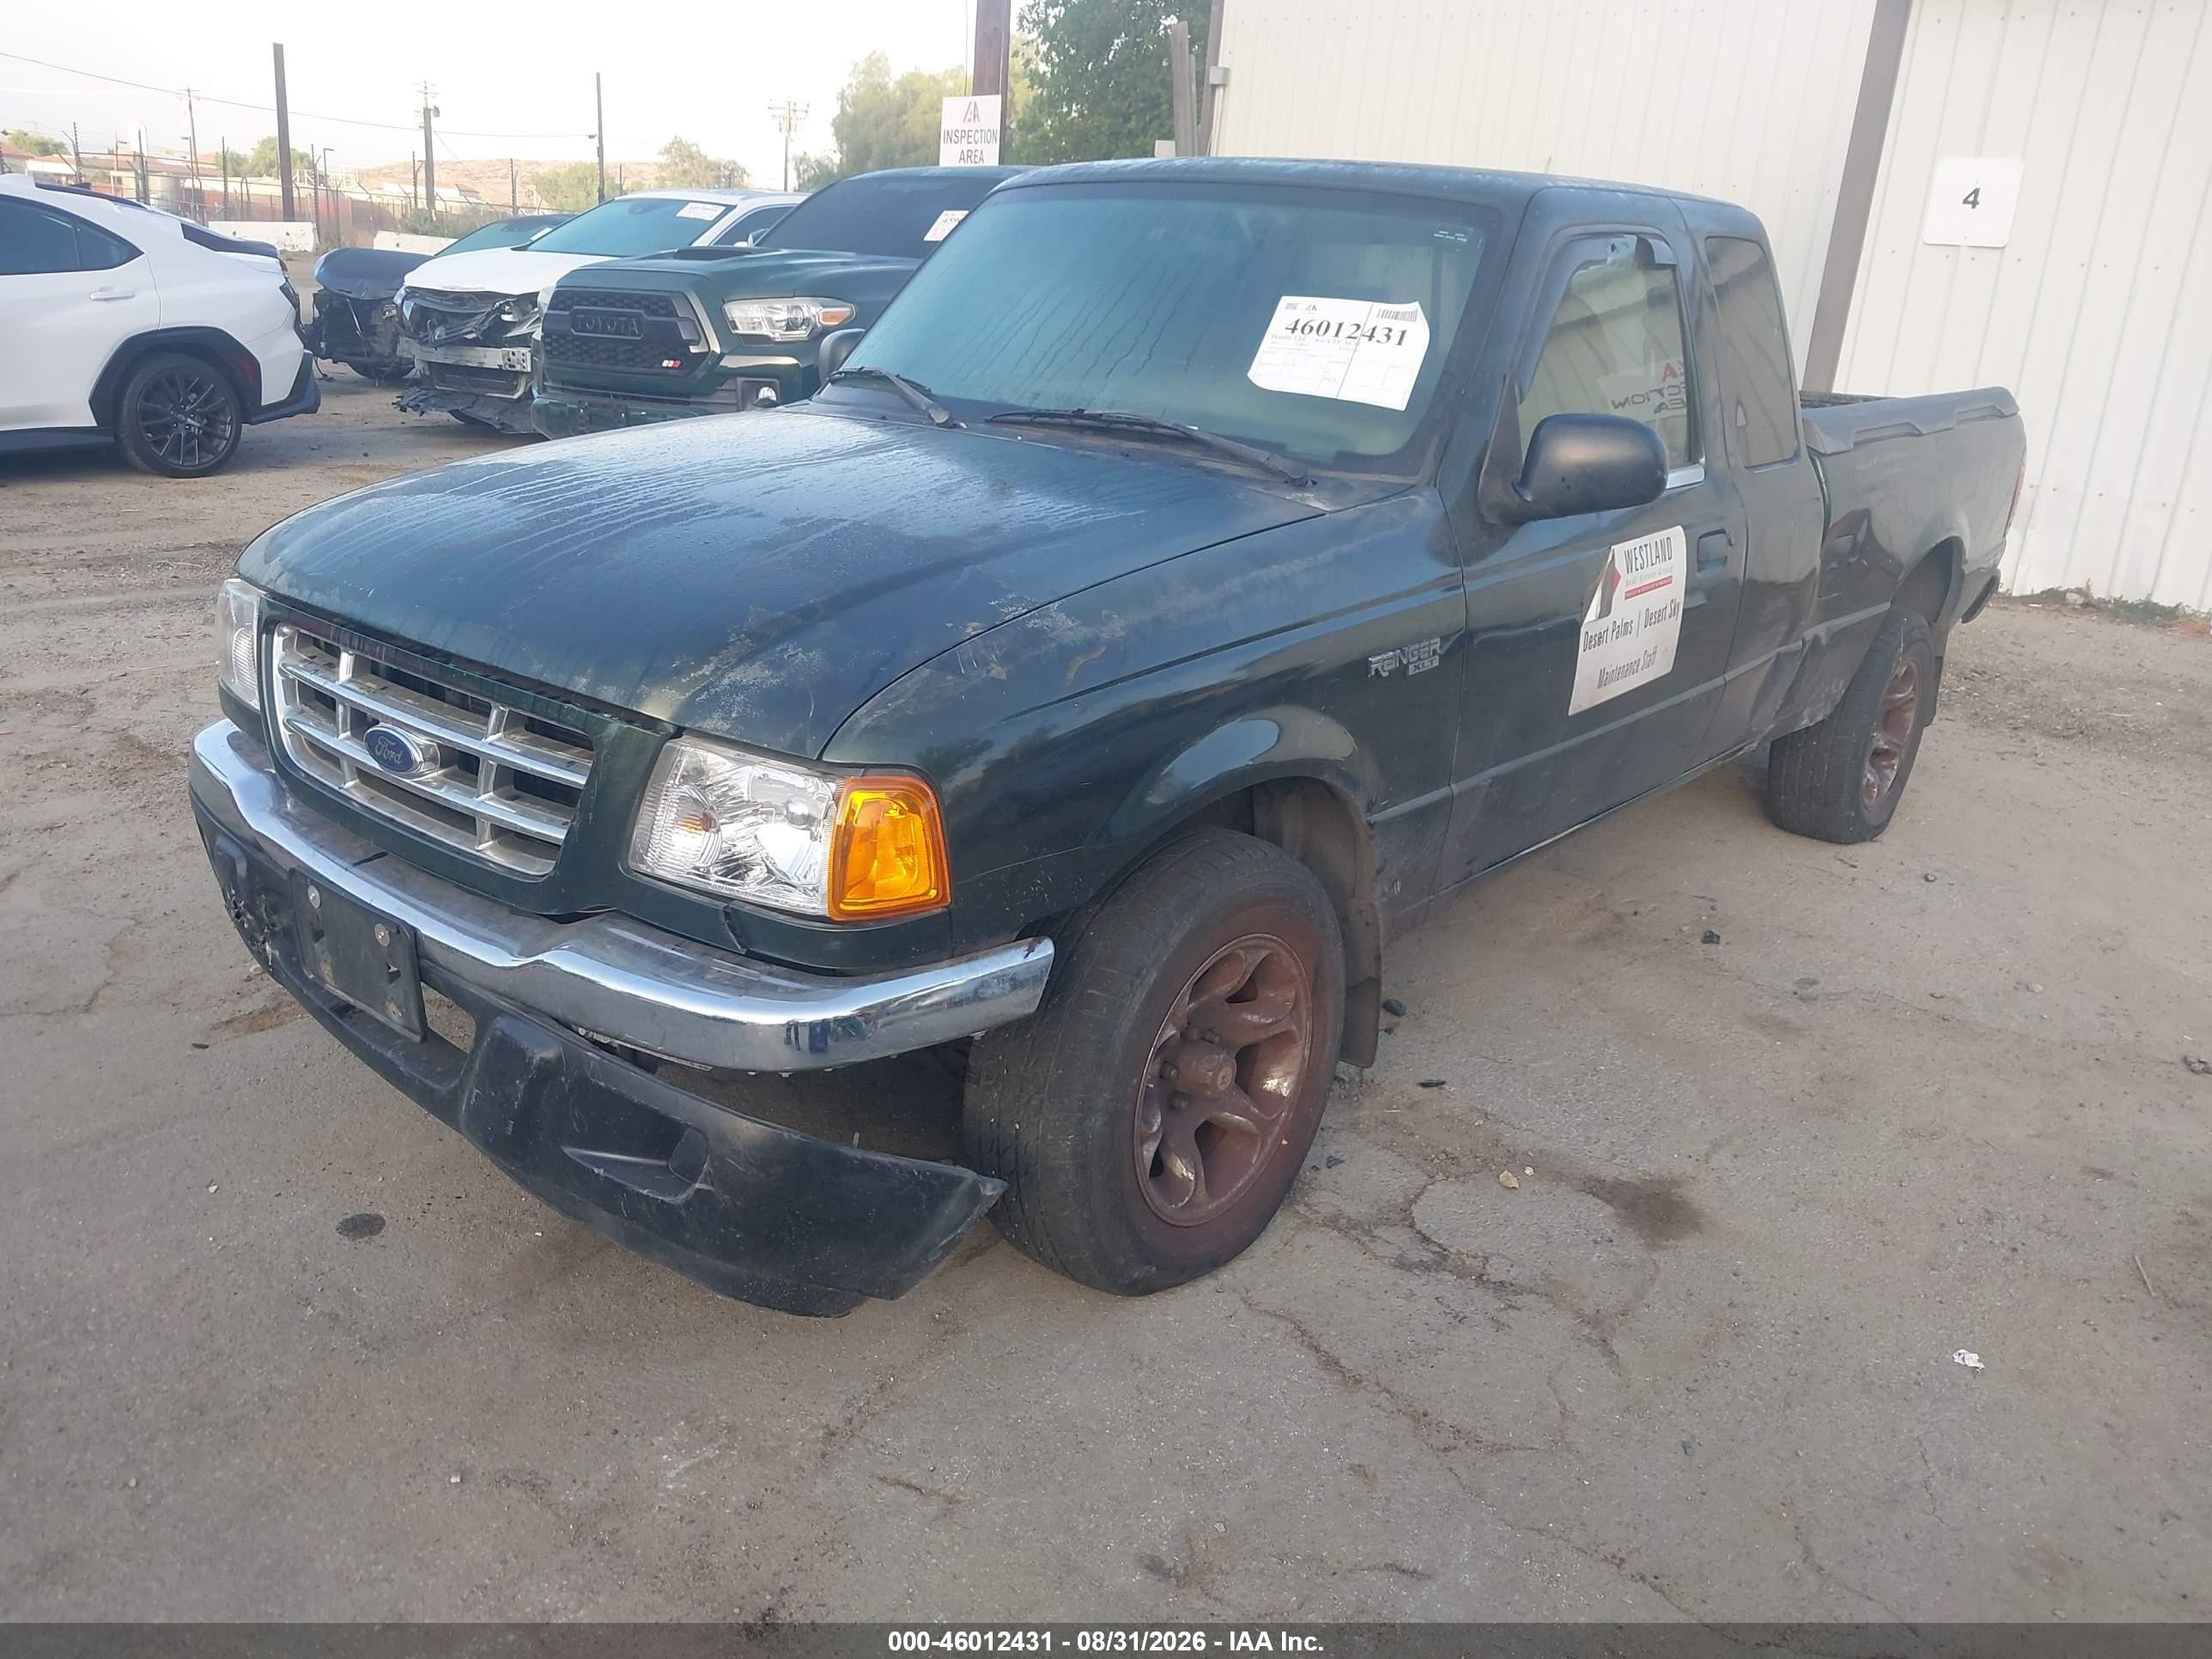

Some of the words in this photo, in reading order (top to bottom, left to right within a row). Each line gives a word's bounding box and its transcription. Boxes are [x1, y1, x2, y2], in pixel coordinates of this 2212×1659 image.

[943, 128, 998, 145] INSPECTION
[958, 149, 985, 165] AREA
[1962, 186, 1980, 210] 4
[575, 313, 640, 337] TOYOTA
[1284, 317, 1408, 347] 46012431
[1624, 536, 1674, 574] WESTLAND
[1583, 626, 1608, 653] Desert
[1611, 617, 1634, 642] Palms
[1644, 604, 1668, 629] Desert
[1668, 597, 1681, 622] Sky
[1367, 636, 1443, 678] RANGER
[1596, 658, 1641, 689] Maintenance
[1641, 645, 1658, 671] Staff
[374, 736, 404, 764] Ford
